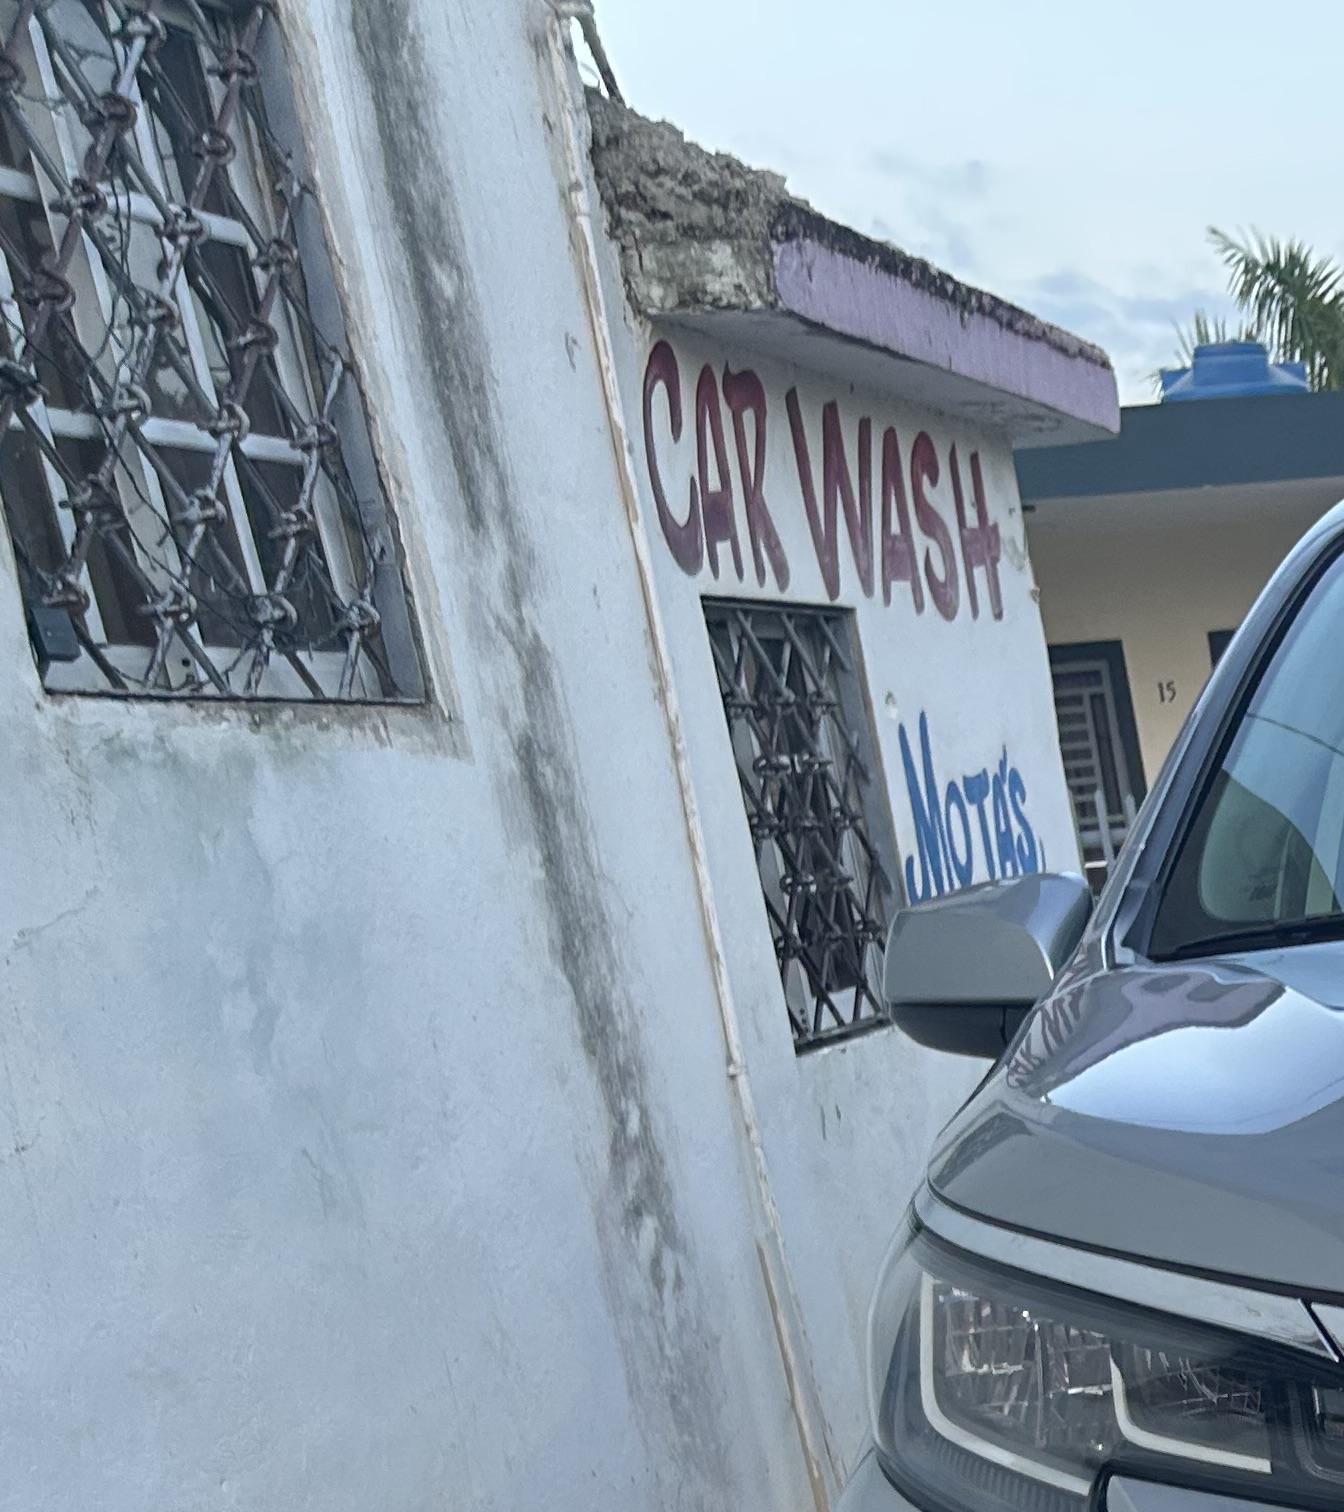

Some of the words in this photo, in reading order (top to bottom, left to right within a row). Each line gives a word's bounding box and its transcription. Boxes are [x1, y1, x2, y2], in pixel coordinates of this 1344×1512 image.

[642, 340, 790, 593] CAR
[785, 386, 1004, 622] WASH
[1158, 680, 1176, 703] 15
